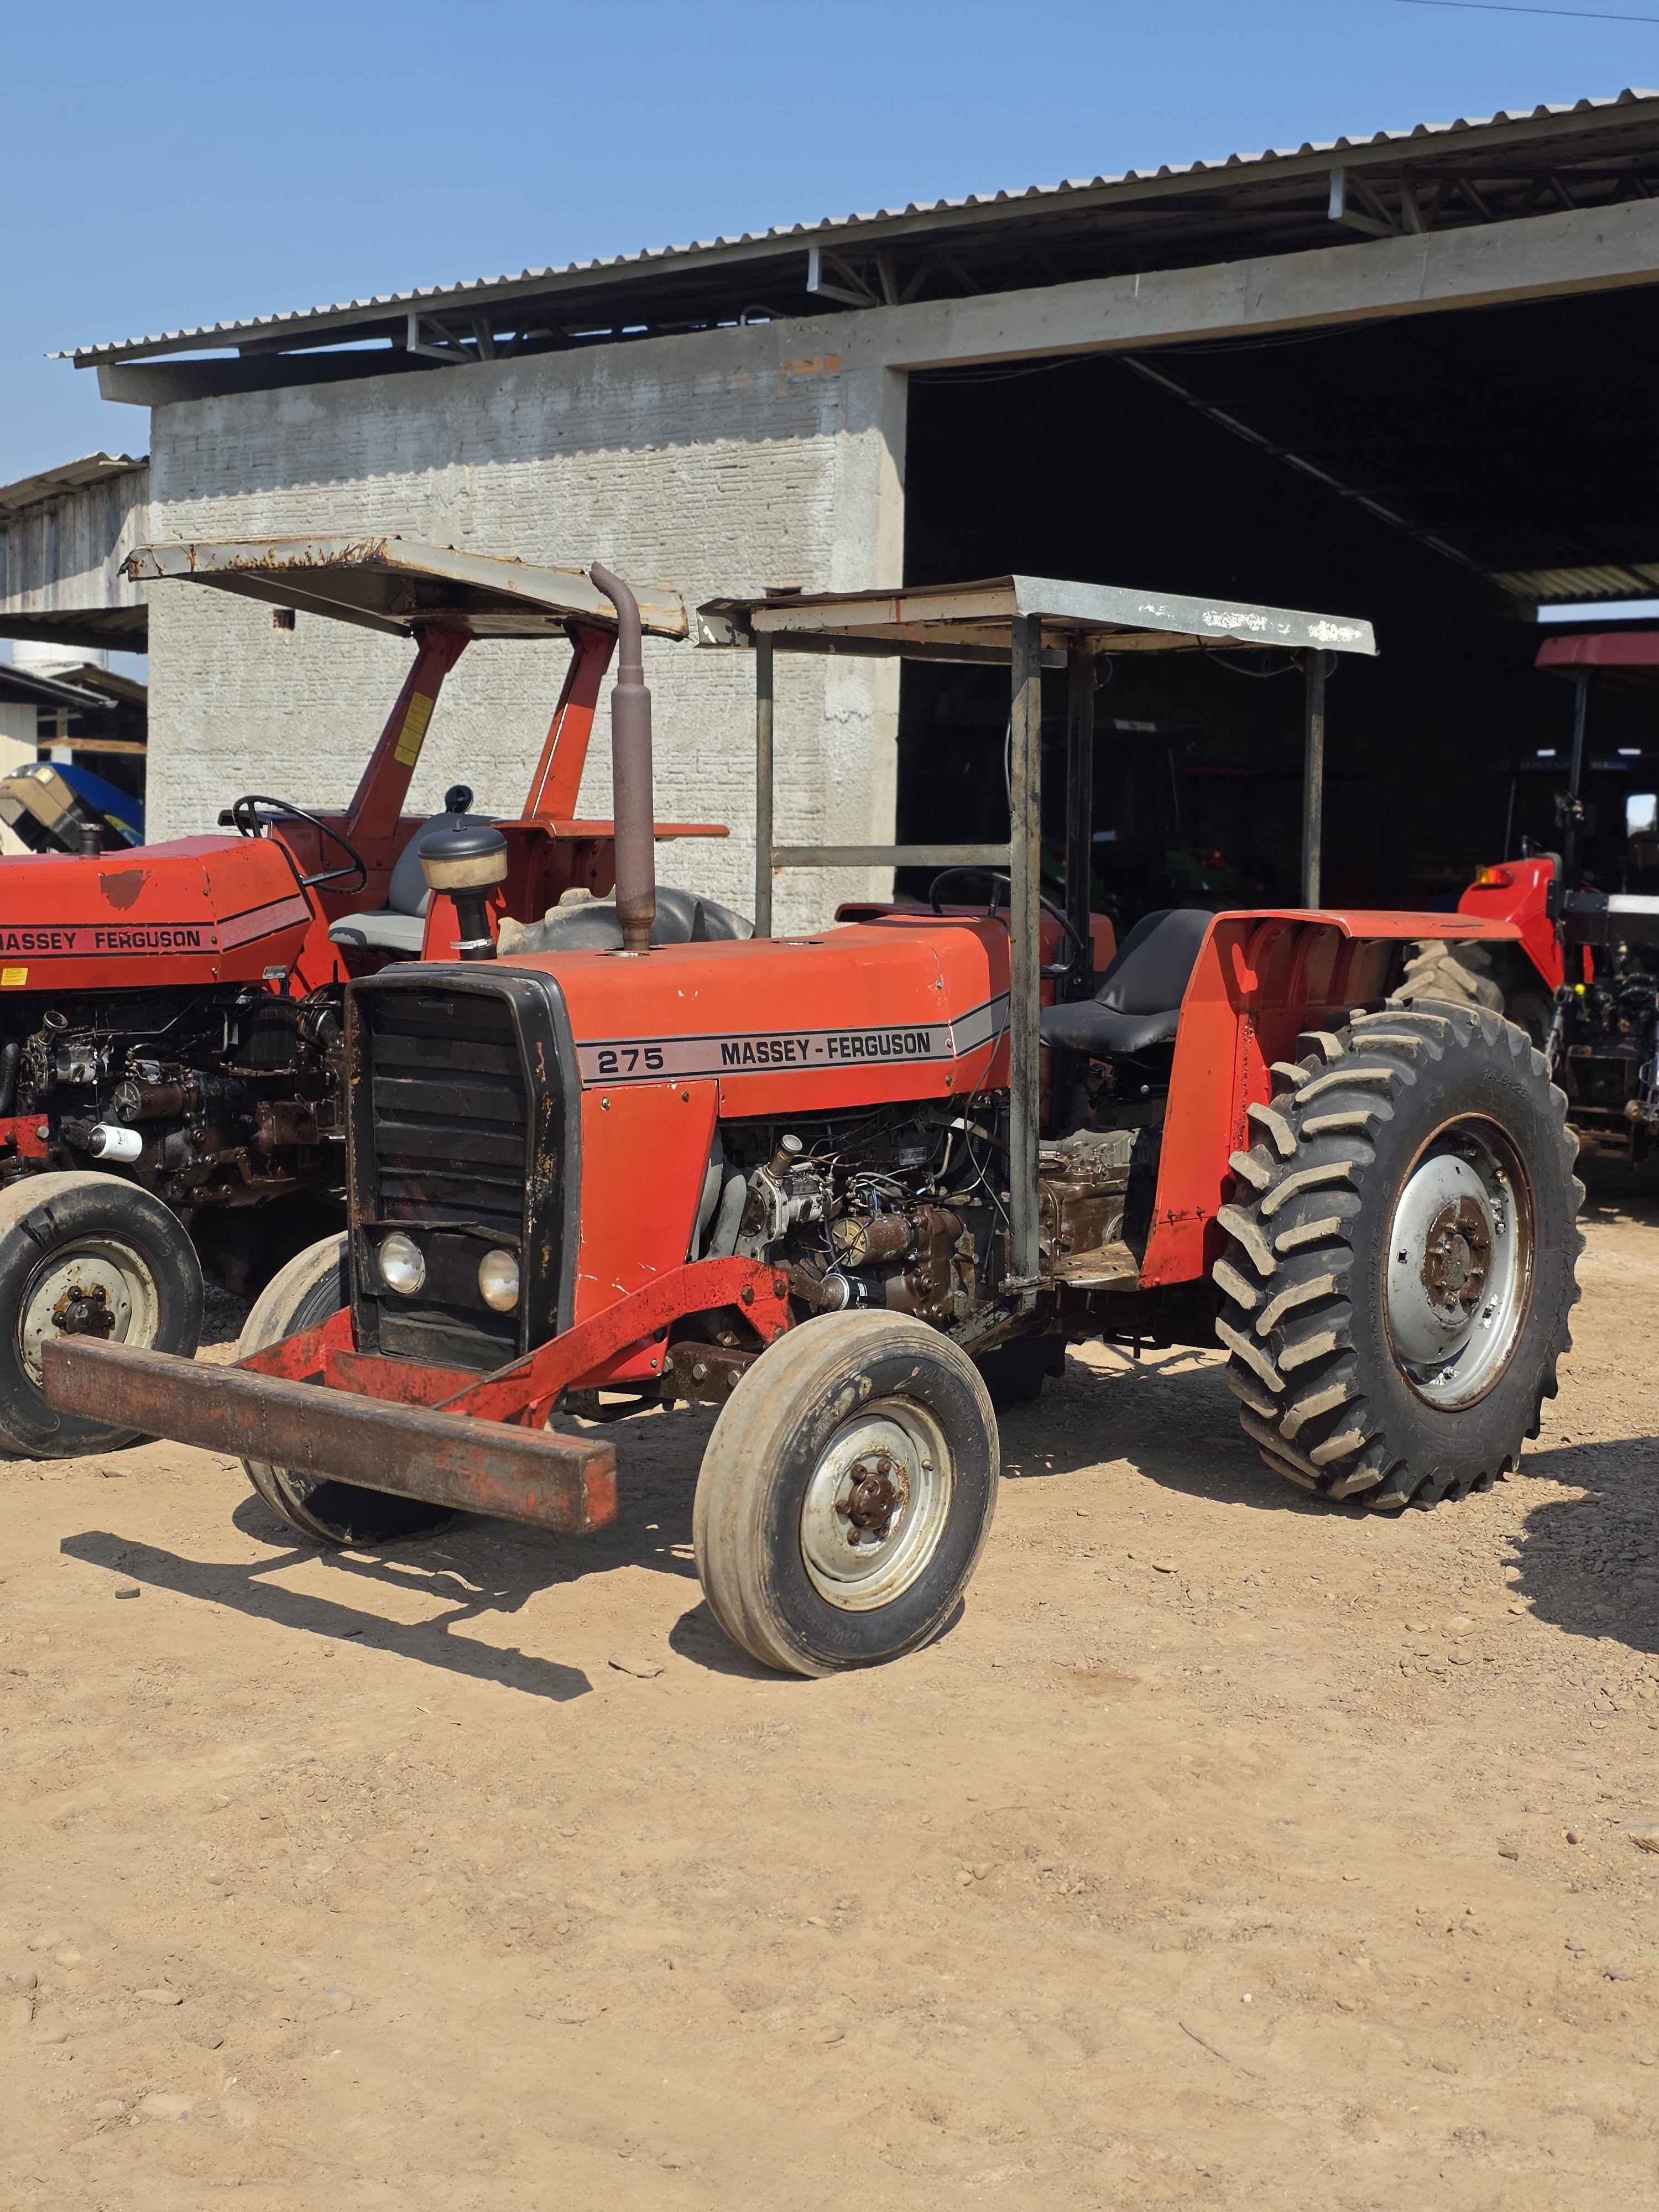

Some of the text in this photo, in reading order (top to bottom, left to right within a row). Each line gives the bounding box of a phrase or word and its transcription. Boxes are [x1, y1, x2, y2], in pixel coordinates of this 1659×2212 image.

[0, 930, 201, 951] ASSEY FERGUSON
[597, 1047, 664, 1074] 275
